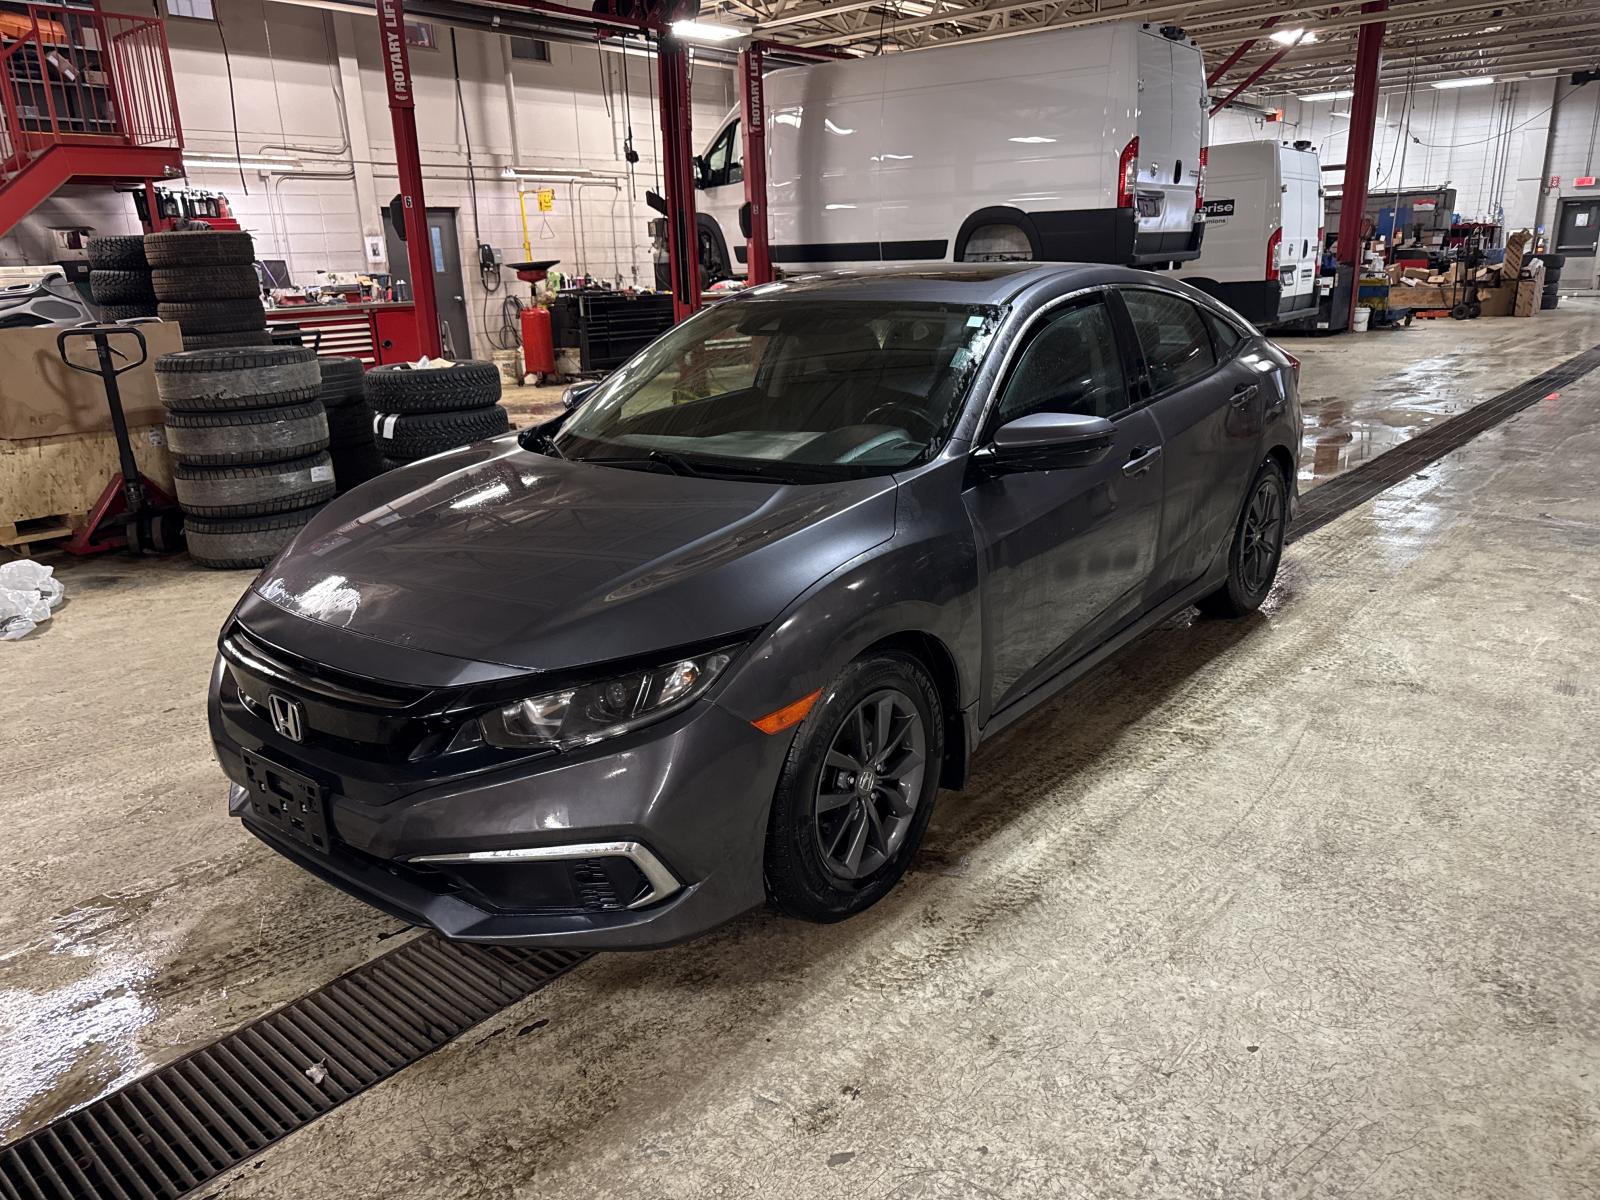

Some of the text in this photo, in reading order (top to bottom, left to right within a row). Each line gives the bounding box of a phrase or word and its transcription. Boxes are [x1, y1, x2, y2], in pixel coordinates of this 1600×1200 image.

[387, 31, 407, 92] ROTARY
[749, 53, 761, 126] ROTARY LIFT
